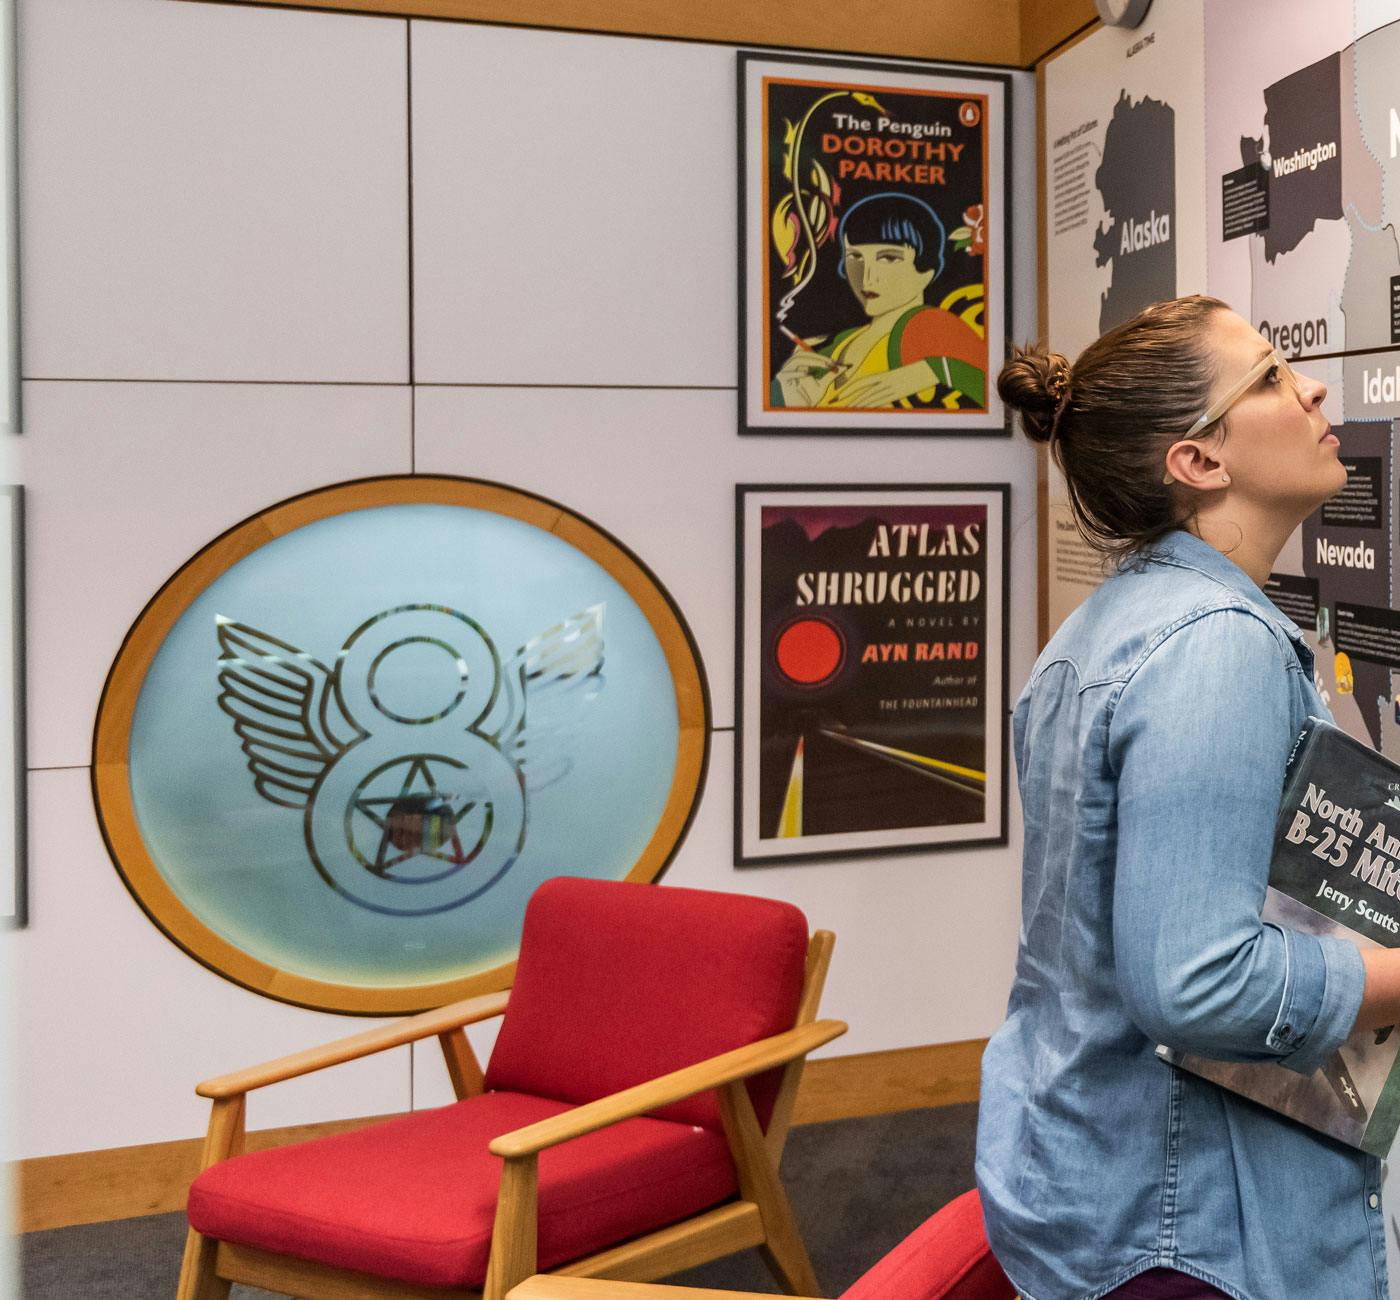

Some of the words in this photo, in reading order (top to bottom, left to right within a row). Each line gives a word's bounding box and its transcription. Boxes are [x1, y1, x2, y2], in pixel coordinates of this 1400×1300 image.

[833, 114, 871, 132] The
[878, 118, 952, 140] Penguin
[822, 134, 964, 162] DOROTHY
[1274, 142, 1336, 178] Washington
[839, 160, 945, 185] PARKER
[1120, 210, 1170, 256] Alaska
[1260, 318, 1328, 358] Oregon
[868, 523, 980, 557] ATLAS
[1316, 538, 1375, 570] Nevada
[796, 570, 981, 606] SHRUGGED
[889, 618, 896, 628] A
[907, 617, 954, 628] NOVEL
[963, 616, 980, 627] BY
[862, 643, 908, 663] AYN
[916, 642, 978, 662] RAND
[933, 675, 964, 687] Author
[966, 674, 977, 686] of
[880, 699, 899, 710] THE
[902, 697, 978, 709] FOUNTAINHEAD
[1300, 782, 1364, 838] North
[1284, 810, 1353, 870] B-25
[1316, 879, 1353, 912] Jerry
[1355, 896, 1400, 934] Scutts
